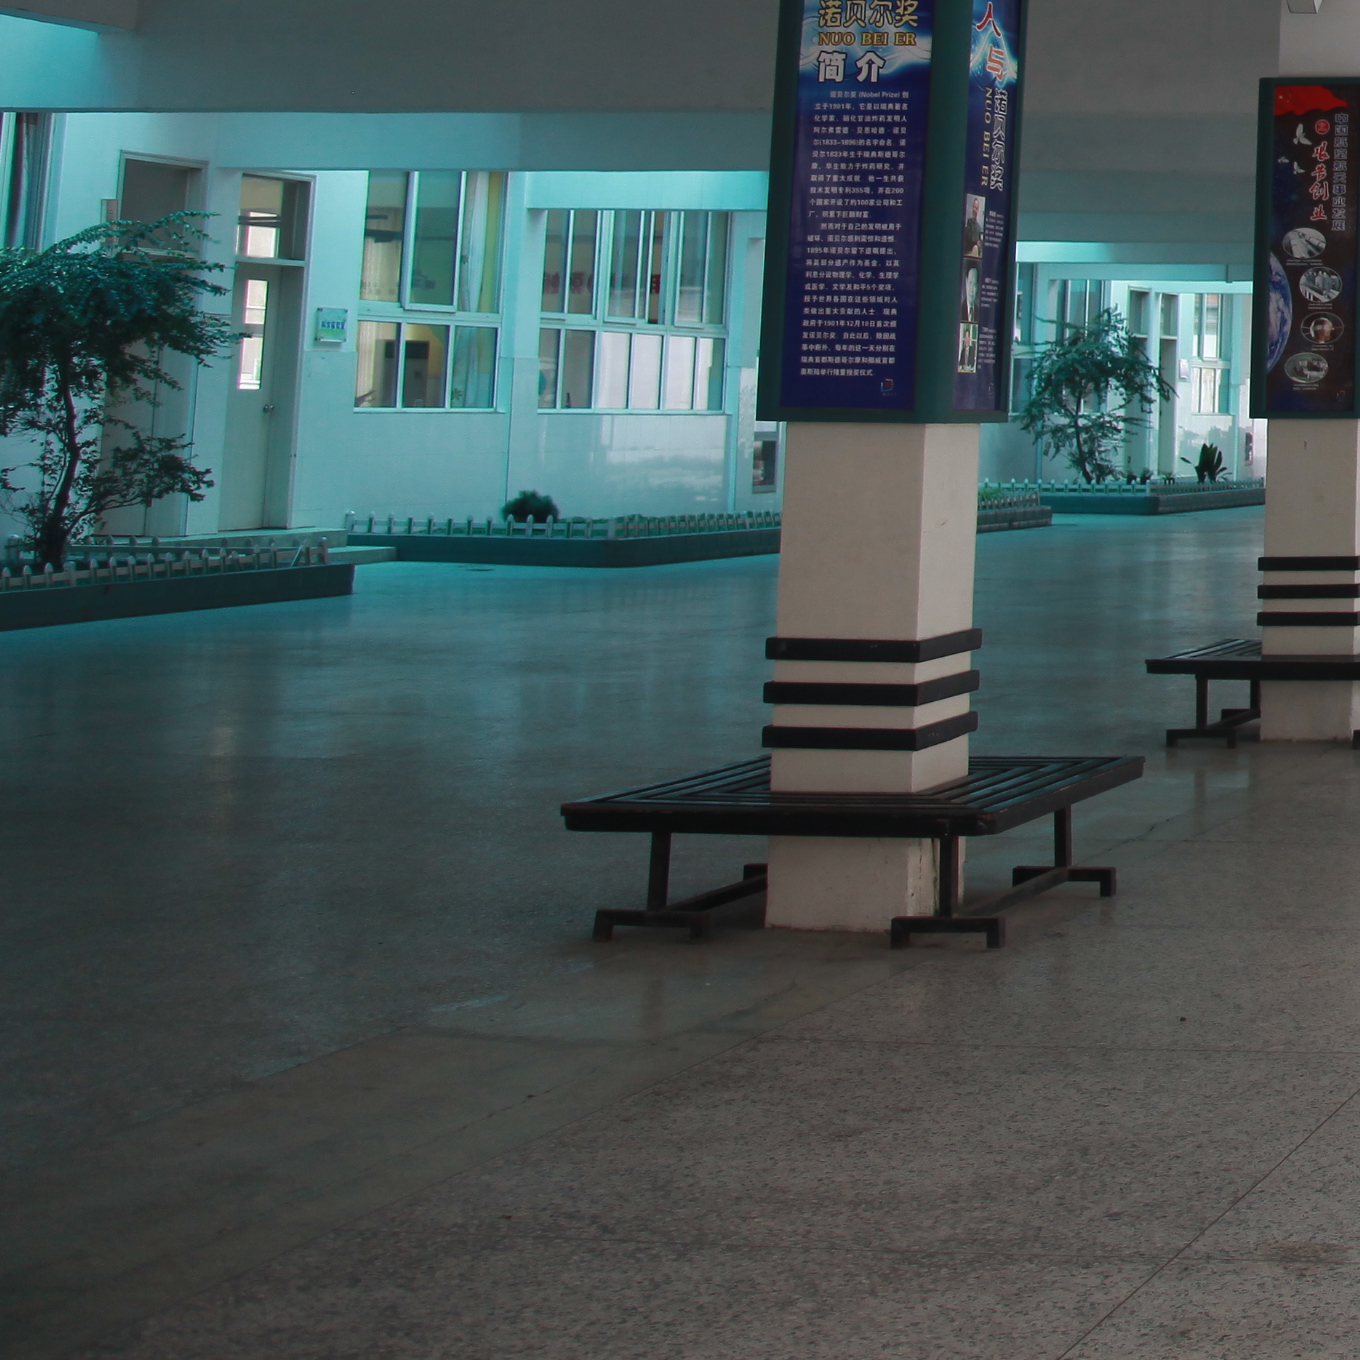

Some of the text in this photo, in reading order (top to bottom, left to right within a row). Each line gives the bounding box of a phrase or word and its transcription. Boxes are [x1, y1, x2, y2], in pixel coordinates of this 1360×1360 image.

[818, 0, 919, 28] 诺贝尔奖
[818, 32, 917, 46] NUO BEI ER
[818, 51, 886, 83] 简介
[981, 87, 993, 186] NUO BEI ER
